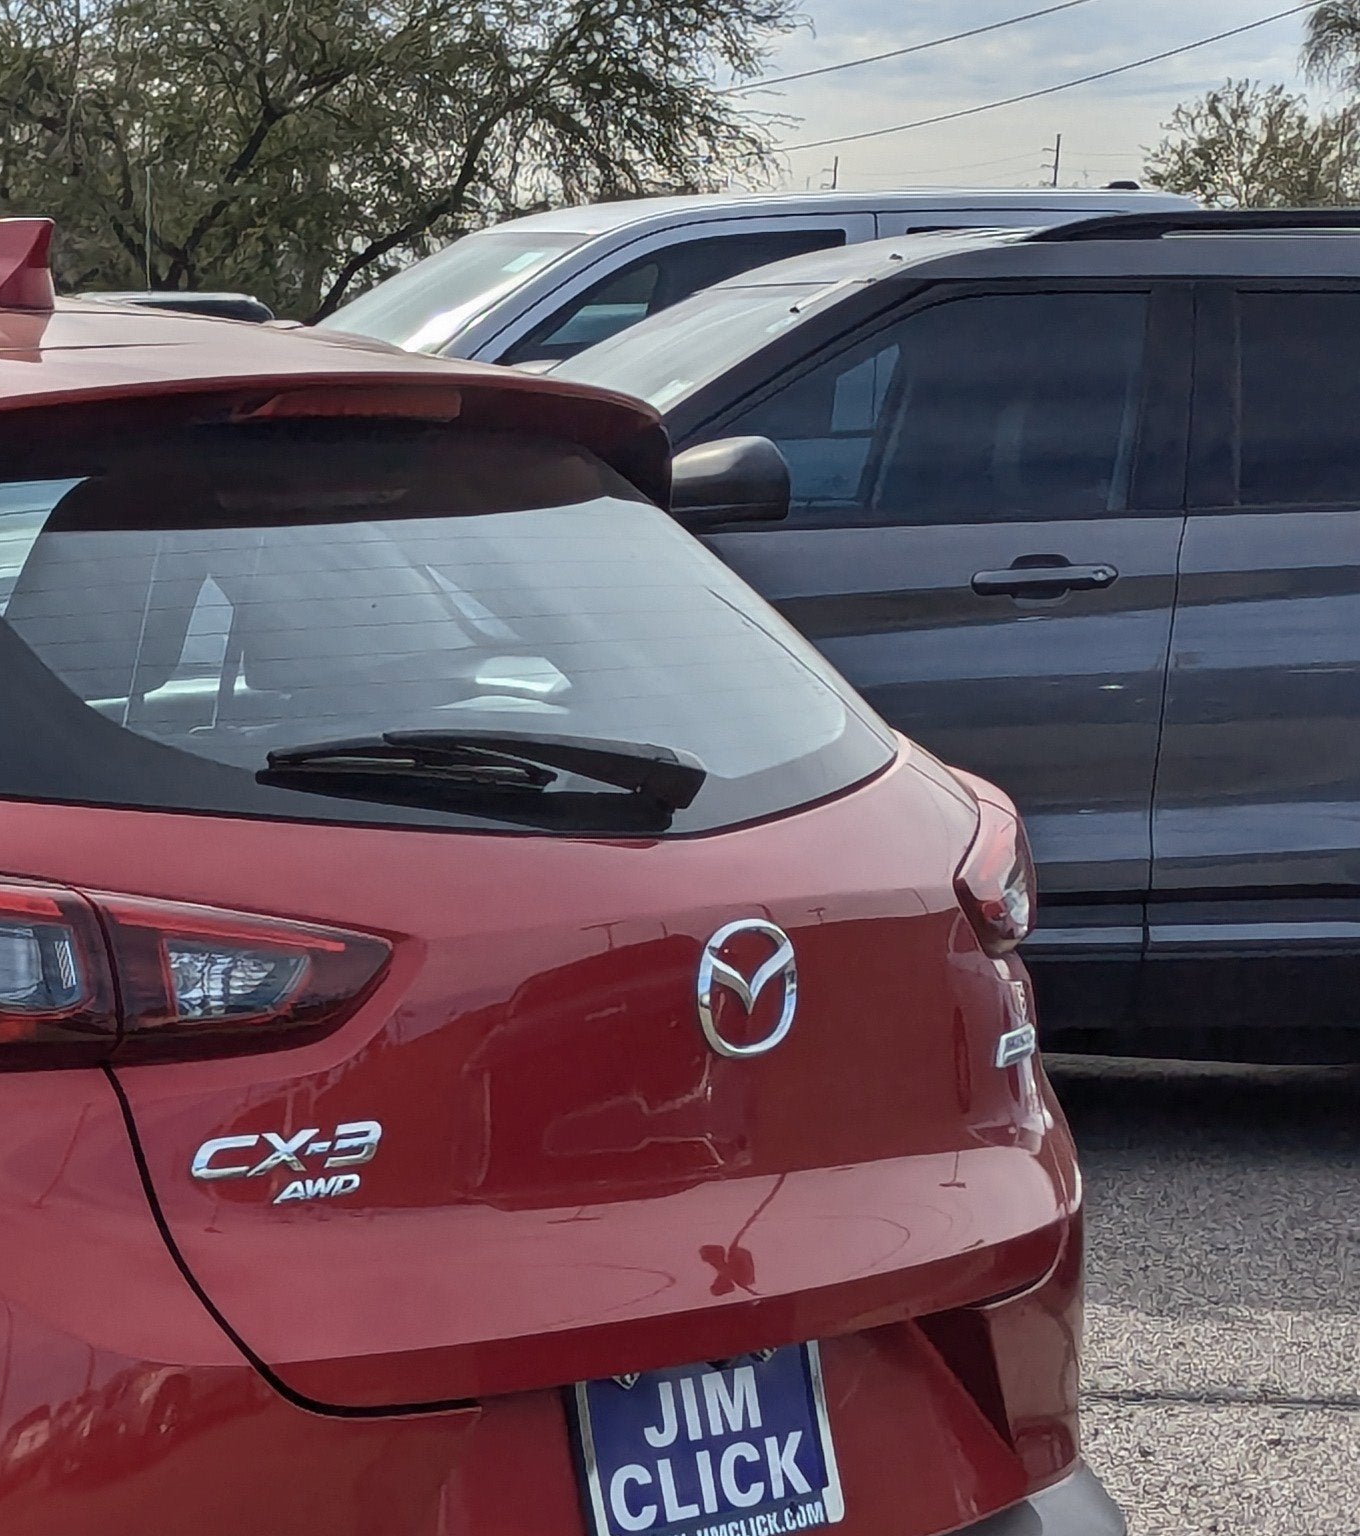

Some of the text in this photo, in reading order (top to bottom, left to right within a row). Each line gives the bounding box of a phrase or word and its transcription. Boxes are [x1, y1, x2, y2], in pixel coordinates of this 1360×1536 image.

[191, 1120, 382, 1179] CX-3
[273, 1173, 361, 1204] AWD
[643, 1365, 762, 1448] JIM
[610, 1430, 812, 1532] CLICK
